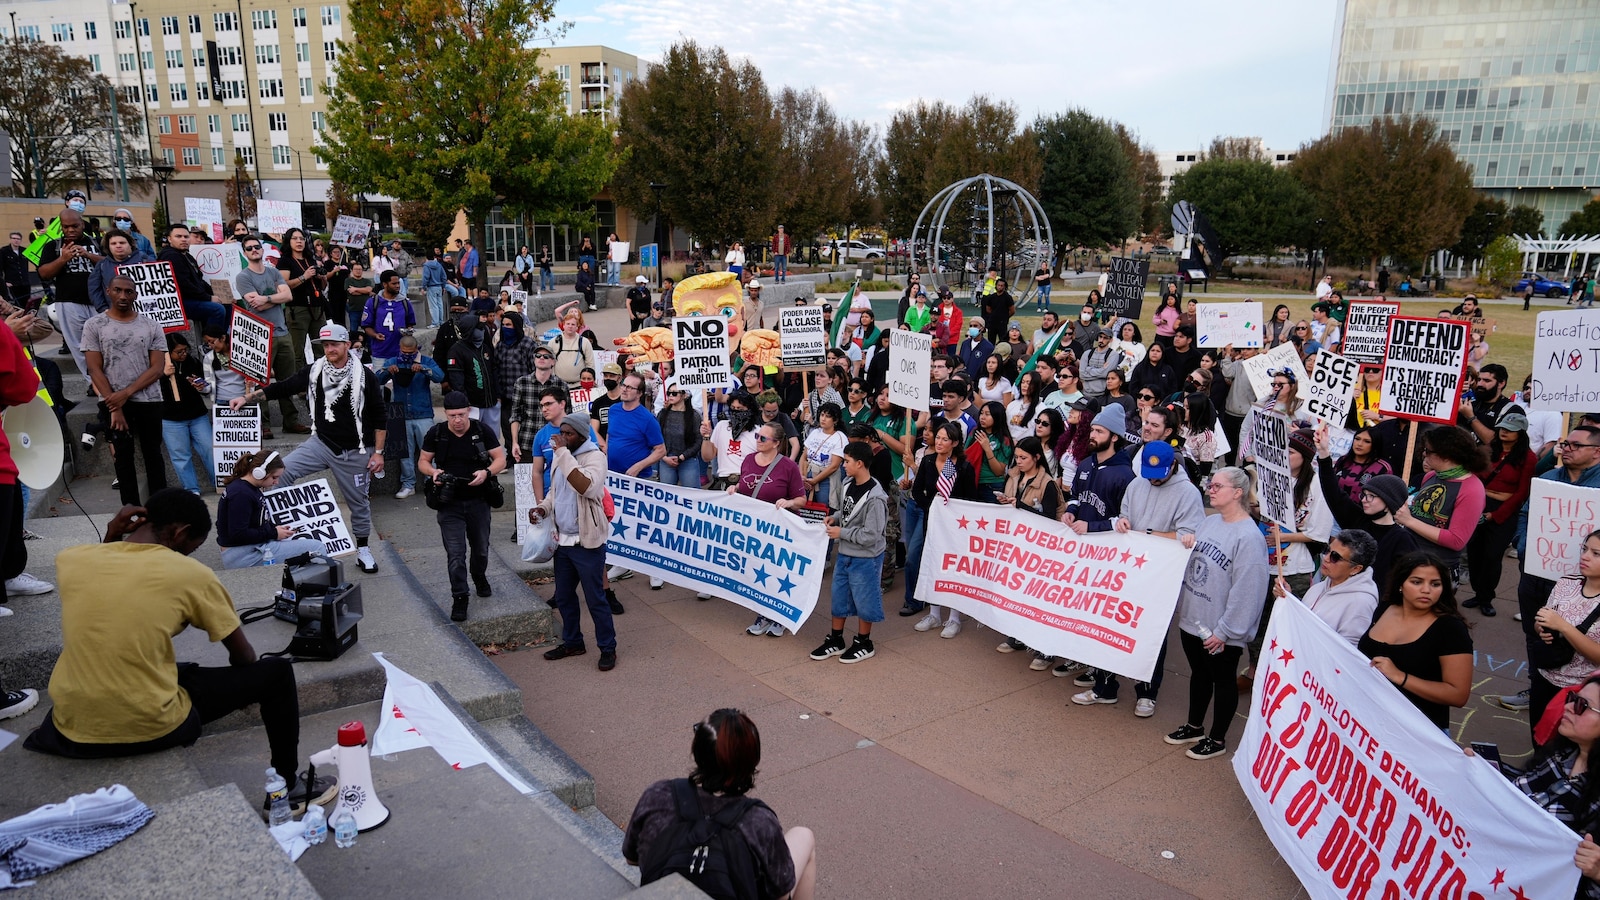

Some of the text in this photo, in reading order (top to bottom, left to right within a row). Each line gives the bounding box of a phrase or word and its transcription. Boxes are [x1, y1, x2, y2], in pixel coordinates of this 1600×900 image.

[119, 262, 173, 281] END THE
[1110, 258, 1141, 275] NO ONE
[134, 279, 176, 297] TACKS
[1116, 272, 1144, 287] ILLEGAL
[1106, 282, 1146, 300] ON STOLEN
[156, 296, 180, 311] OUR
[804, 308, 821, 316] PARA
[1200, 304, 1218, 319] Keep
[1351, 305, 1397, 315] THE PEOPLE
[141, 309, 183, 322] THCARE!
[382, 311, 395, 332] 4
[782, 316, 822, 327] LA CLASE
[234, 316, 269, 340] ¡DINERO
[677, 319, 724, 338] NO
[1366, 325, 1388, 333] DEFEN
[1392, 320, 1464, 350] DEFEND
[1538, 316, 1600, 341] Educatio
[232, 329, 268, 357] PUEBLO,
[678, 337, 725, 351] BORDER
[890, 331, 931, 352] COMPASSION
[1345, 336, 1387, 345] IMMIGRAN
[231, 351, 240, 361] LA
[232, 342, 267, 368] NO PARA
[681, 355, 724, 369] PATROL
[1388, 345, 1460, 367] DEMOCRACY:
[901, 358, 917, 375] OVER
[1316, 351, 1357, 382] ICE
[1385, 366, 1458, 389] IT'S TIME FOR
[679, 372, 728, 386] CHARLOTTE!
[893, 380, 920, 400] CAGES
[1314, 369, 1351, 395] OUT
[570, 389, 592, 403] FEAT
[1310, 385, 1326, 398] OF
[1326, 393, 1346, 410] OUR
[1389, 382, 1447, 403] A GENERAL
[1533, 379, 1600, 405] Deportatio
[1308, 399, 1348, 426] CITY
[1395, 396, 1438, 417] STRIKE!
[222, 419, 259, 430] WORKERS'
[1253, 409, 1287, 450] DEFEND
[215, 431, 259, 442] STRUGGLE
[223, 450, 239, 461] HAS
[1254, 441, 1289, 470] DEMOCRACY:
[1278, 471, 1290, 495] FOR
[266, 483, 330, 513] TRUMP:
[1542, 496, 1596, 521] THIS
[271, 501, 336, 527] END
[604, 475, 794, 544] HE PEOPLE UNITED WILL
[307, 516, 341, 531] WAR
[610, 492, 812, 577] FEND IMMIGRANT
[1541, 515, 1595, 538] IS FOR
[635, 522, 748, 576] FAMILIES!
[994, 518, 1118, 562] EL PUEBLO UNIDO
[1536, 536, 1573, 560] OUR
[969, 535, 1127, 592] DEFENDERÁ A LAS
[1193, 540, 1233, 571] LVATORE
[1541, 556, 1581, 576] PEOPL
[606, 542, 619, 552] OR
[620, 546, 661, 564] SOCIALISM
[662, 559, 679, 570] AND
[680, 565, 725, 584] LIBERATION
[737, 585, 794, 617] @PSLCHARLOTTE
[942, 553, 1145, 630] FAMILIAS MIGRANTES!
[937, 582, 963, 592] PARTY
[964, 586, 977, 595] FOR
[1003, 601, 1037, 618] LIBERATION
[1040, 613, 1073, 628] CHARLOTTE
[1075, 623, 1131, 650] @PSLNATIONAL
[1302, 670, 1471, 858] CHARLOTTE DEMANDS:
[1279, 701, 1312, 749] &
[1304, 718, 1398, 853] BORDER
[1391, 813, 1486, 900] PATR
[1252, 731, 1381, 900] OUT OF OUR
